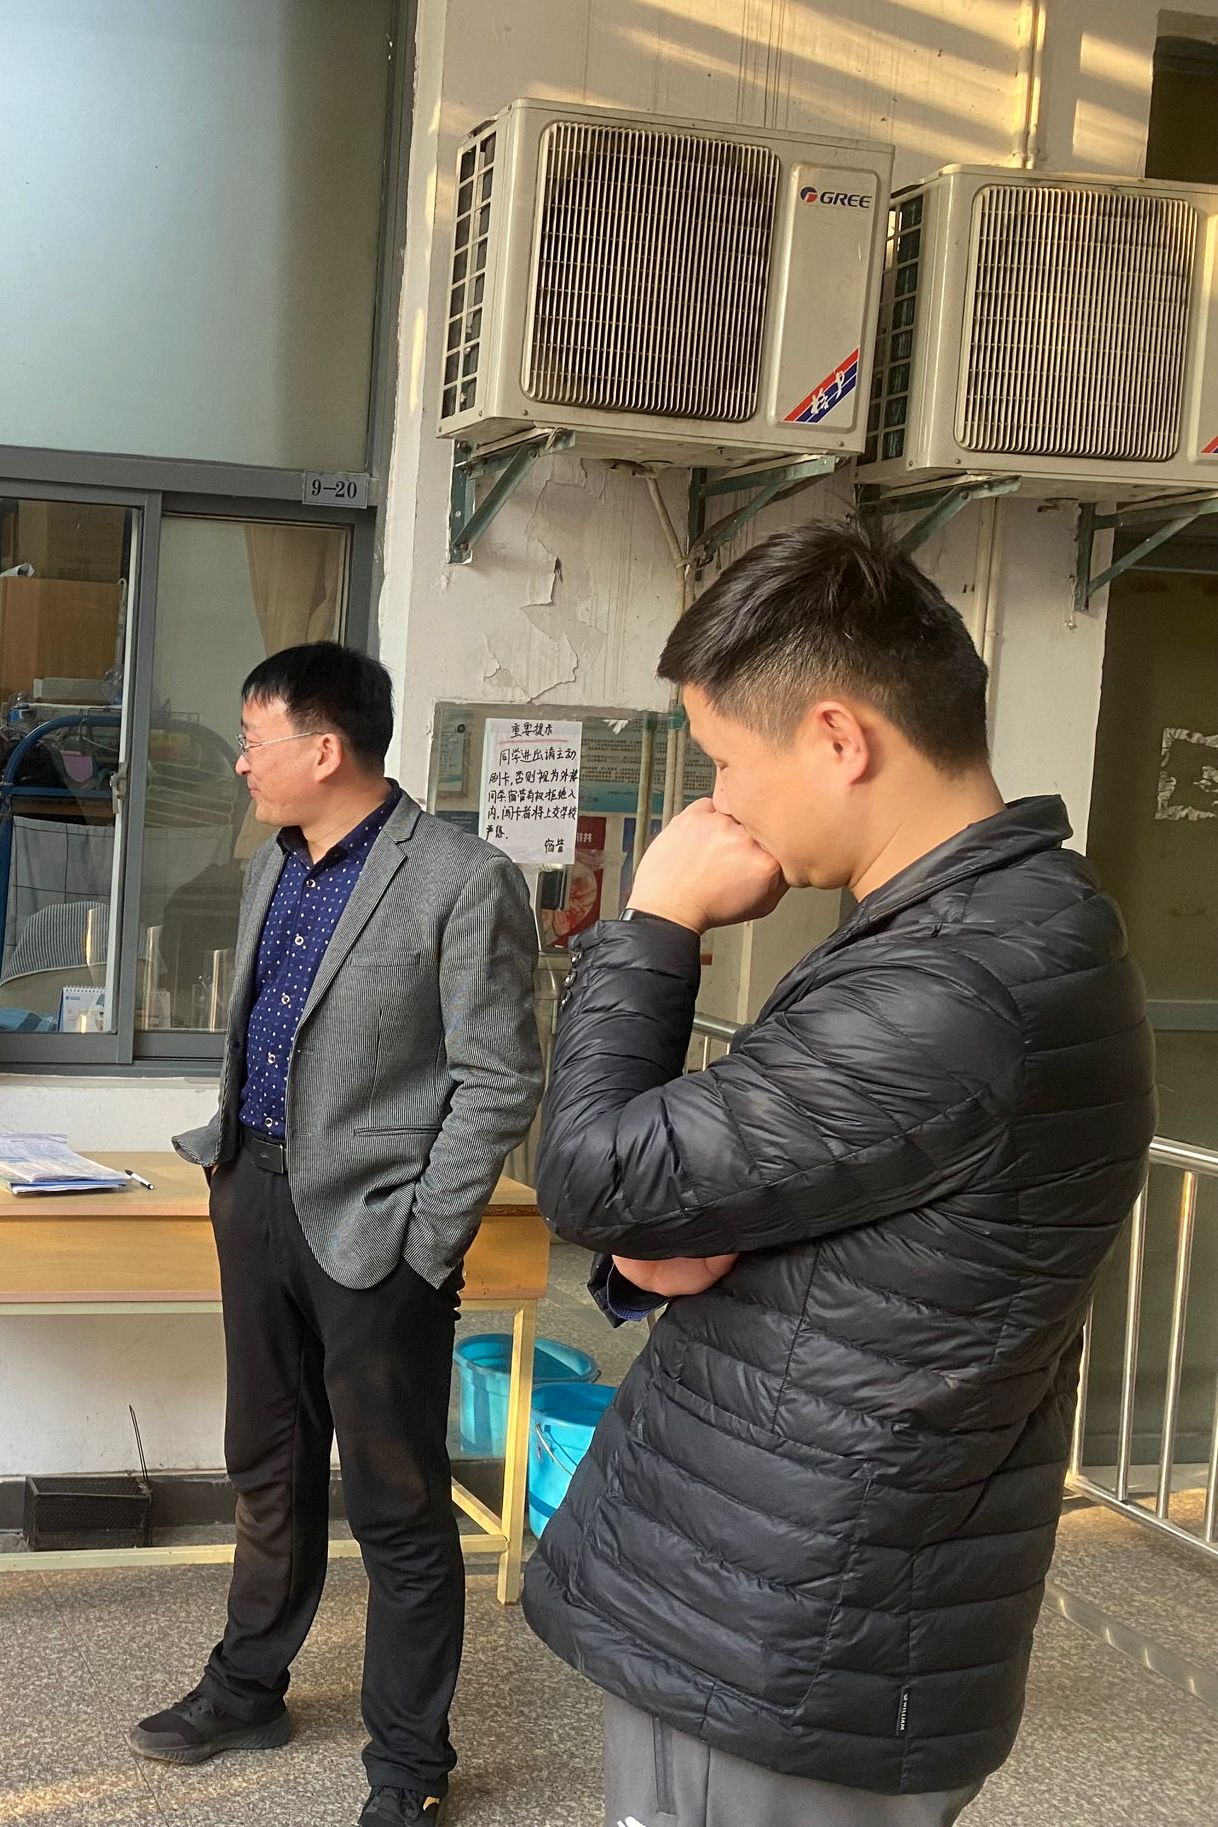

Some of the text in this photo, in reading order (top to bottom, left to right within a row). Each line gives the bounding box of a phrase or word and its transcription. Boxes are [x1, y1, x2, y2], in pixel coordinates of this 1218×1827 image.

[820, 191, 872, 208] GREE
[311, 479, 357, 498] 9-20
[510, 722, 552, 738] 重要提示
[499, 746, 576, 766] 同学进出请主动
